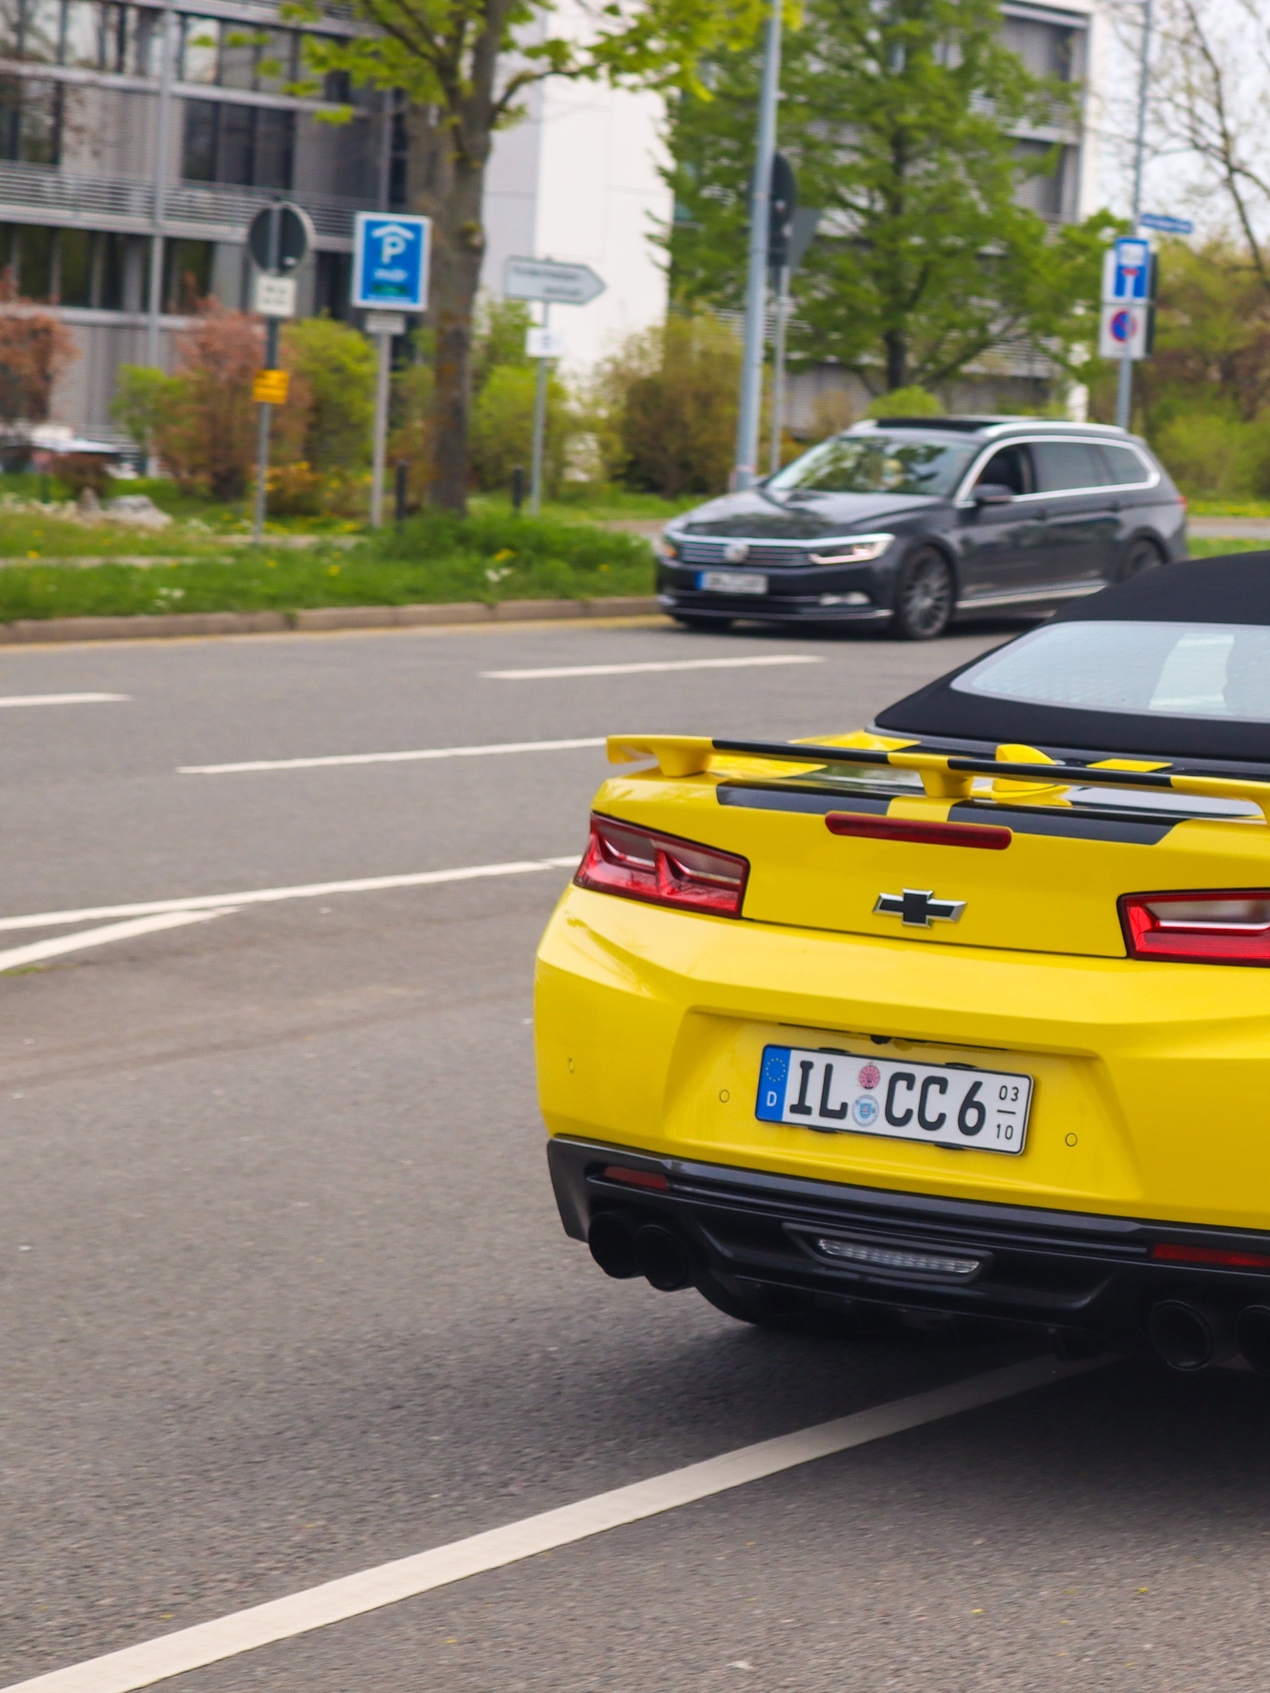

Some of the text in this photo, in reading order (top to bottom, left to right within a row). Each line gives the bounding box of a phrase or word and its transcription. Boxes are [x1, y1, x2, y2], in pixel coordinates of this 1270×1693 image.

[382, 236, 406, 264] P
[766, 1090, 778, 1107] D
[789, 1060, 849, 1120] IL
[998, 1085, 1020, 1102] 03
[996, 1123, 1014, 1140] 10
